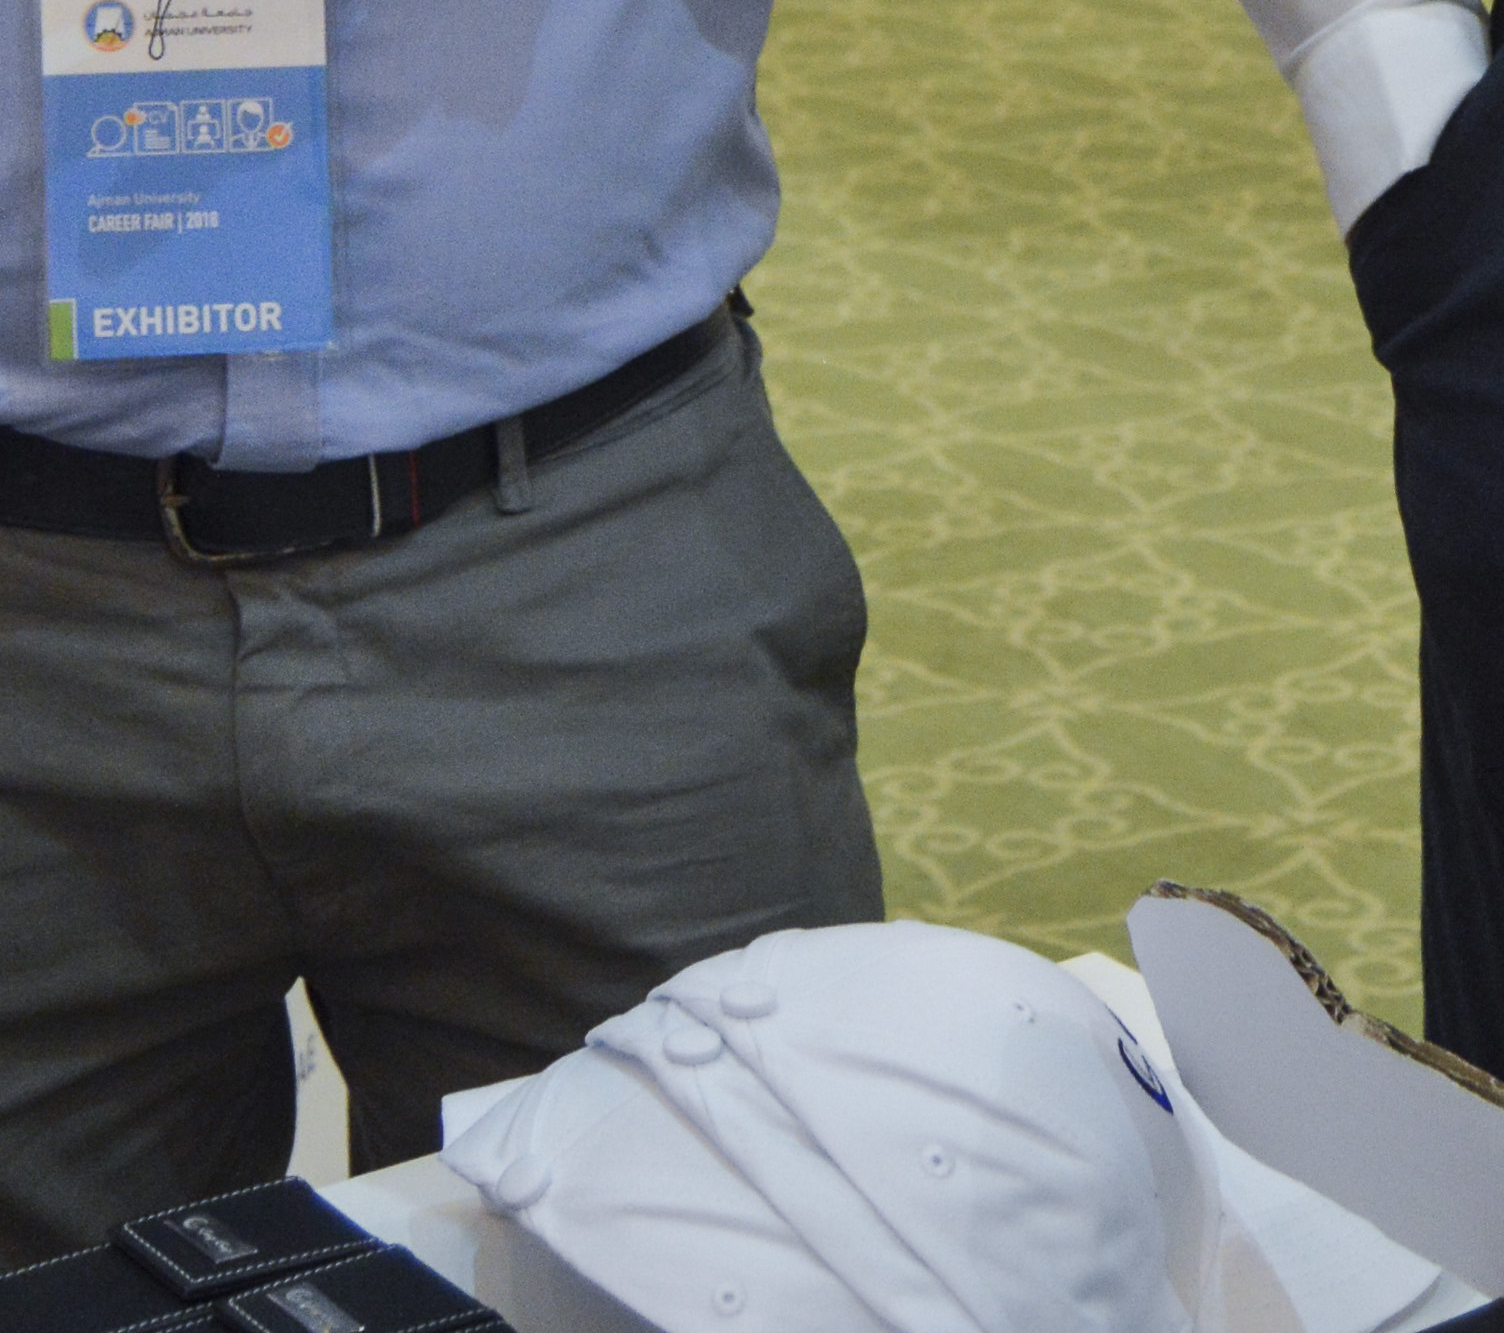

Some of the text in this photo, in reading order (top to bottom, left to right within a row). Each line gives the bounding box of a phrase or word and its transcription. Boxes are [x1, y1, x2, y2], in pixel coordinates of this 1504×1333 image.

[88, 210, 220, 232] CAREER FAIR 2018
[93, 300, 284, 338] EXHIBITOR
